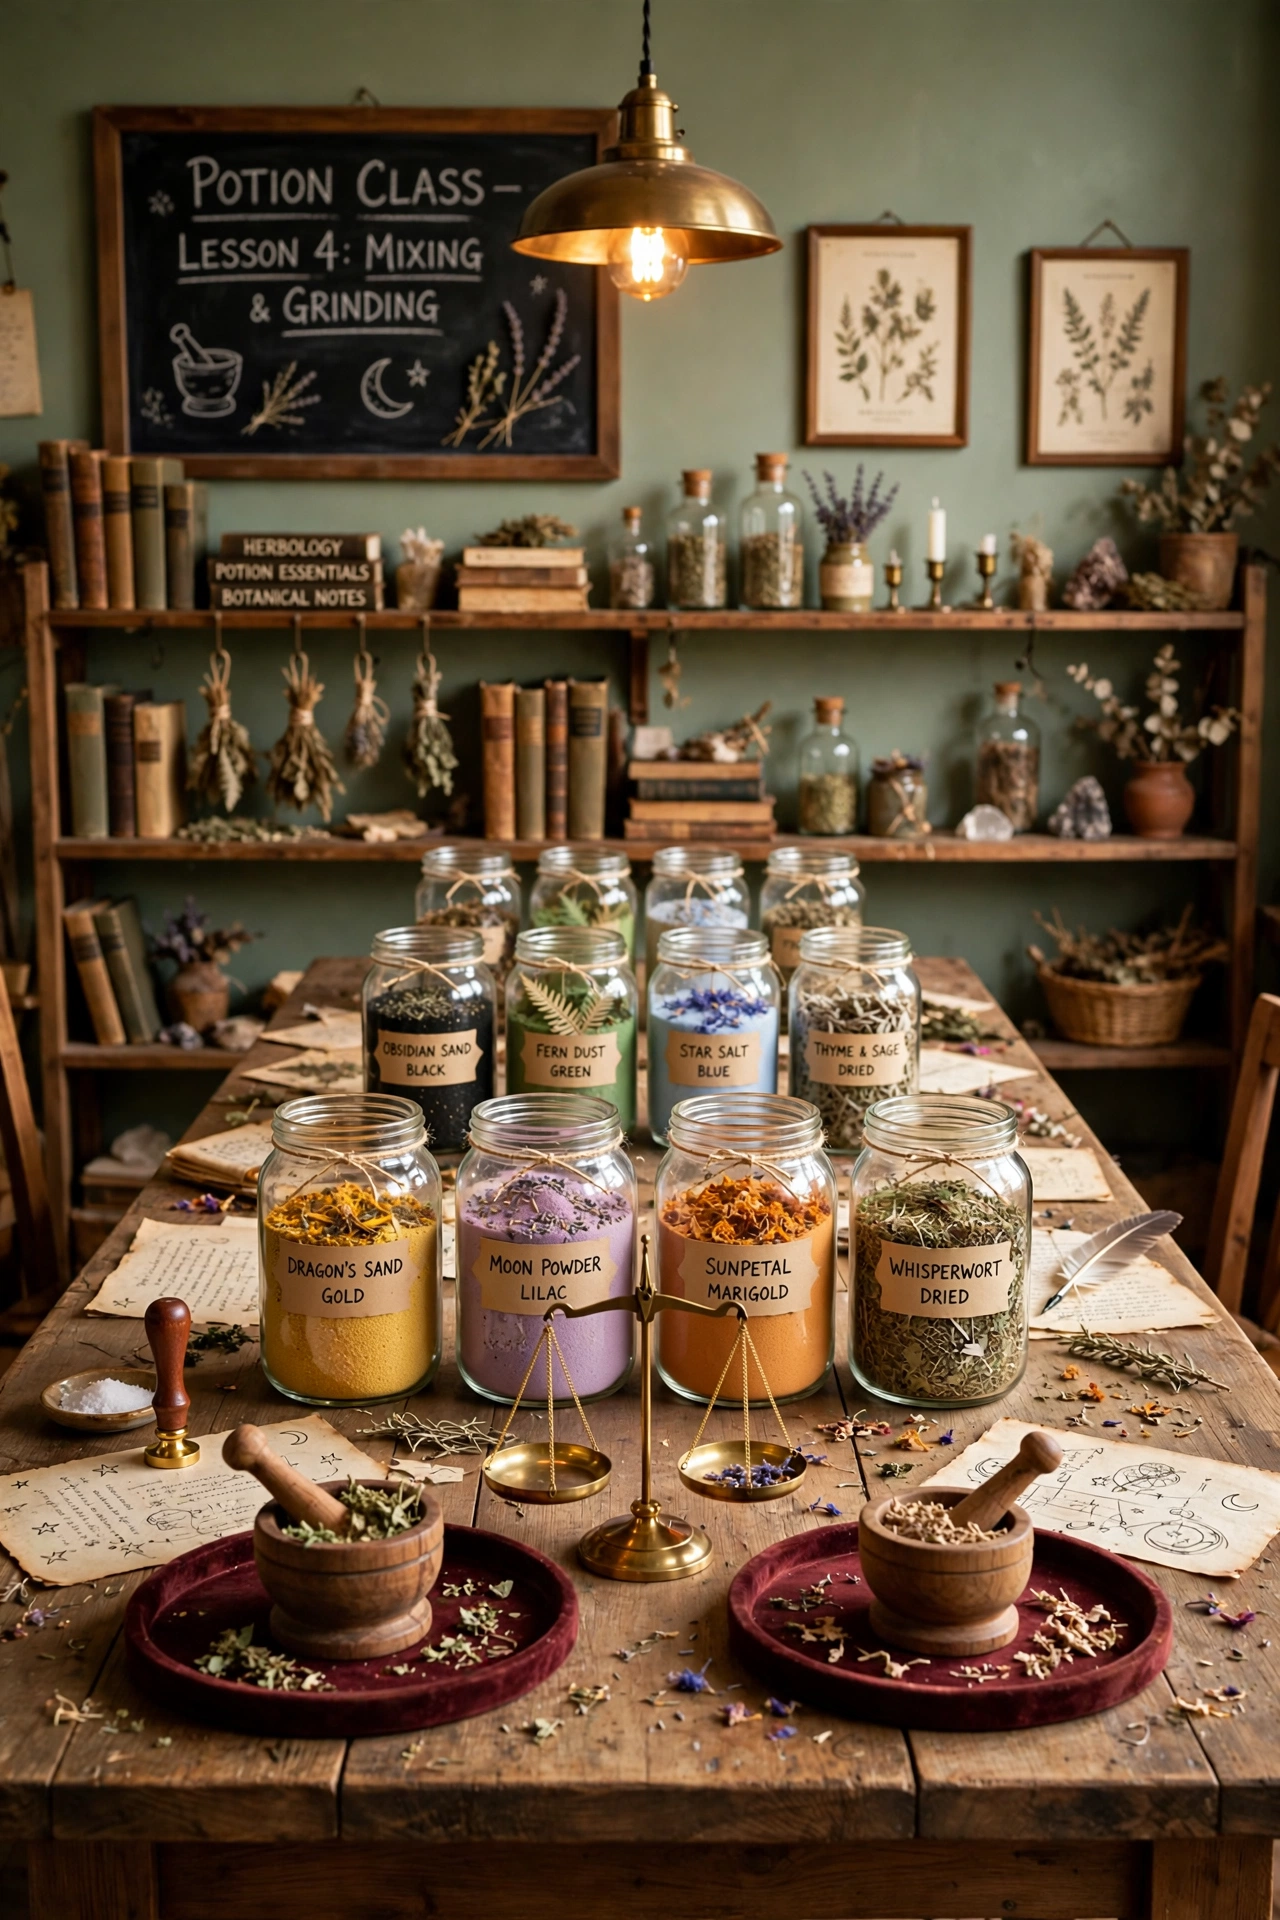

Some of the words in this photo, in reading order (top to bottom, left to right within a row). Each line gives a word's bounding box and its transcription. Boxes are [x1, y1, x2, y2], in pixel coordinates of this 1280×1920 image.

[186, 156, 334, 209] POTION
[178, 232, 300, 271] LESSON
[313, 230, 351, 271] 4:
[365, 233, 483, 272] MIXING
[249, 293, 271, 323] &
[283, 286, 439, 325] GRINDING
[243, 537, 343, 557] HERBOLOGY
[215, 562, 274, 581] POTION
[279, 563, 370, 582] ESSENTIALS
[222, 588, 310, 607] BOTANICAL
[315, 588, 366, 607] NOTES
[382, 1041, 436, 1058] OBSIDIAN
[441, 1042, 472, 1057] SAND
[536, 1043, 568, 1059] FERN
[573, 1045, 606, 1059] DUST
[680, 1043, 712, 1059] STAR
[718, 1044, 749, 1059] SALT
[814, 1041, 853, 1058] THYME
[859, 1046, 868, 1058] &
[872, 1043, 900, 1057] SAGE
[406, 1063, 446, 1077] BLACK
[549, 1064, 592, 1078] GREEN
[697, 1064, 730, 1078] BLUE
[838, 1063, 874, 1077] DRIED
[287, 1256, 357, 1279] DRAGON'S
[363, 1257, 404, 1278] SAND
[489, 1254, 534, 1277] MOON
[541, 1255, 602, 1277] POWDER
[705, 1256, 792, 1277] SUNPETAL
[889, 1256, 1003, 1280] WHISPERWORT
[321, 1287, 365, 1305] GOLD
[520, 1284, 568, 1301] LILAC
[707, 1283, 789, 1303] MARIGOLD
[920, 1287, 969, 1305] DRIED
